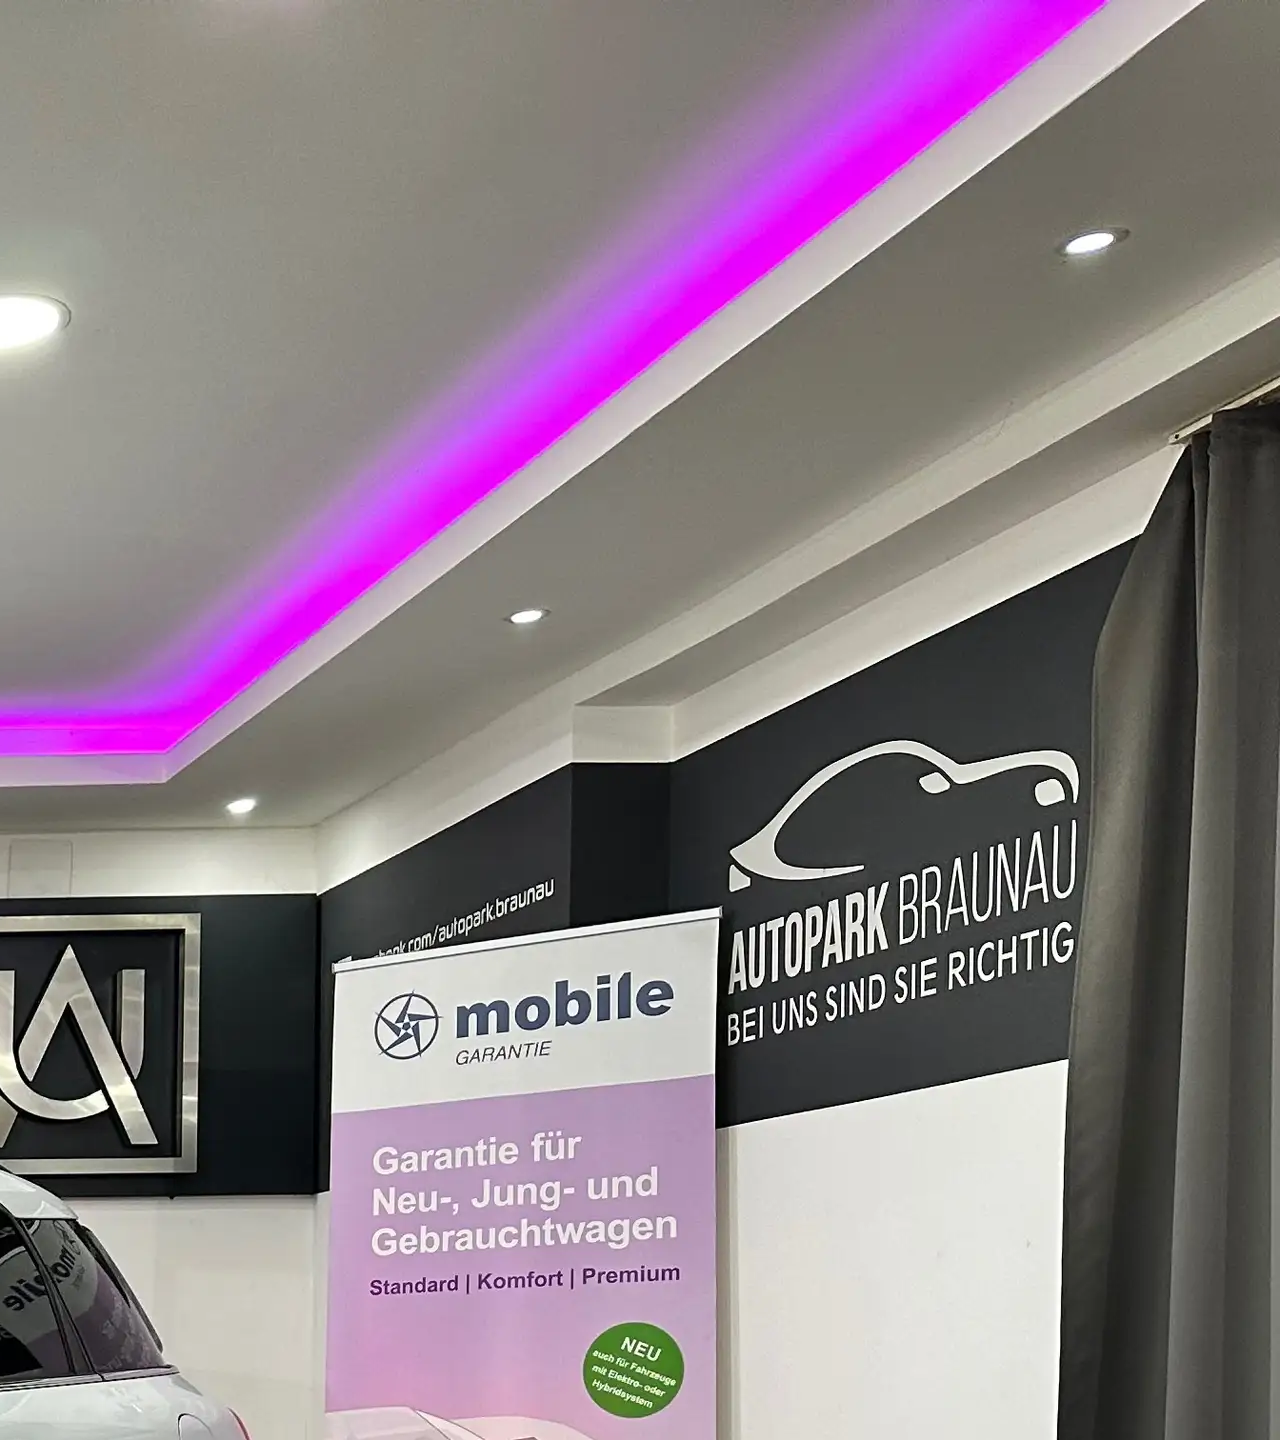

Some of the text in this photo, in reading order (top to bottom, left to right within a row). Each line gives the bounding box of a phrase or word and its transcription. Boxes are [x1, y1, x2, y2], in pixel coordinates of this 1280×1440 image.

[727, 819, 1077, 995] AUTOPARK BRAUNAU
[727, 920, 1076, 1046] BEI UNS SIND SIE RICHTIG
[456, 971, 675, 1039] mobile
[455, 1039, 553, 1066] GARANTIE
[372, 1129, 582, 1176] Garantie für
[372, 1165, 659, 1216] Neu-, Jung- und
[371, 1213, 678, 1257] Gebrauchtwagen
[369, 1274, 459, 1296] Standard
[477, 1269, 564, 1291] Komfort
[581, 1264, 681, 1286] Premium
[592, 1349, 677, 1387] auch für Fahrzeuge
[620, 1336, 662, 1362] NEU
[591, 1364, 667, 1397] mit Elektro- oder
[591, 1378, 654, 1409] Hybridsystem
